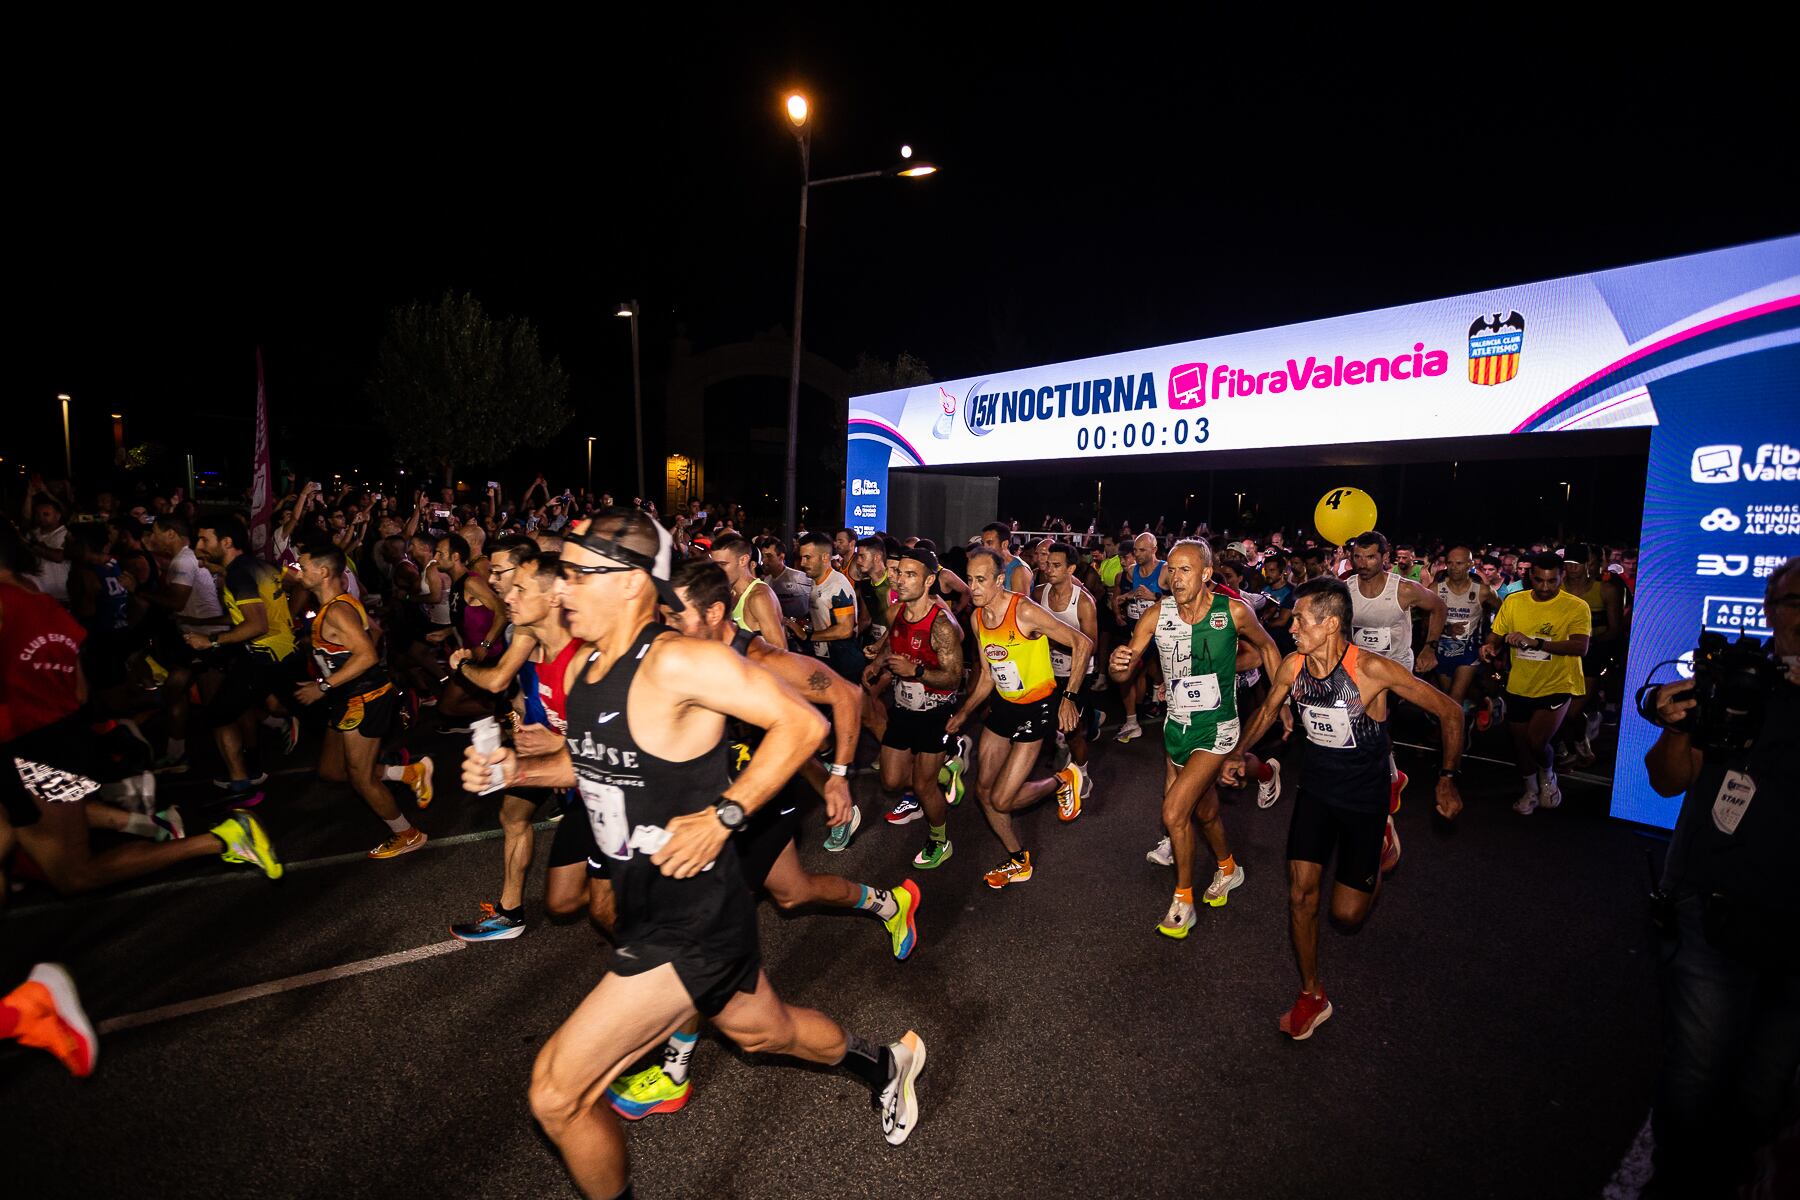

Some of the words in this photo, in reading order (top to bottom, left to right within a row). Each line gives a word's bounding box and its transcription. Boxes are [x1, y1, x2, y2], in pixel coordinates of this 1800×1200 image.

[1470, 339, 1501, 348] VALENCIA
[1503, 335, 1521, 344] CLUB
[1471, 343, 1519, 356] ATLETISMO
[1211, 343, 1448, 400] fibraValencia
[1000, 372, 1157, 424] NOCTURNA
[1077, 417, 1210, 450] 00:00:03
[20, 635, 47, 661] CLUB
[1187, 689, 1201, 699] 69
[1310, 720, 1334, 733] 788
